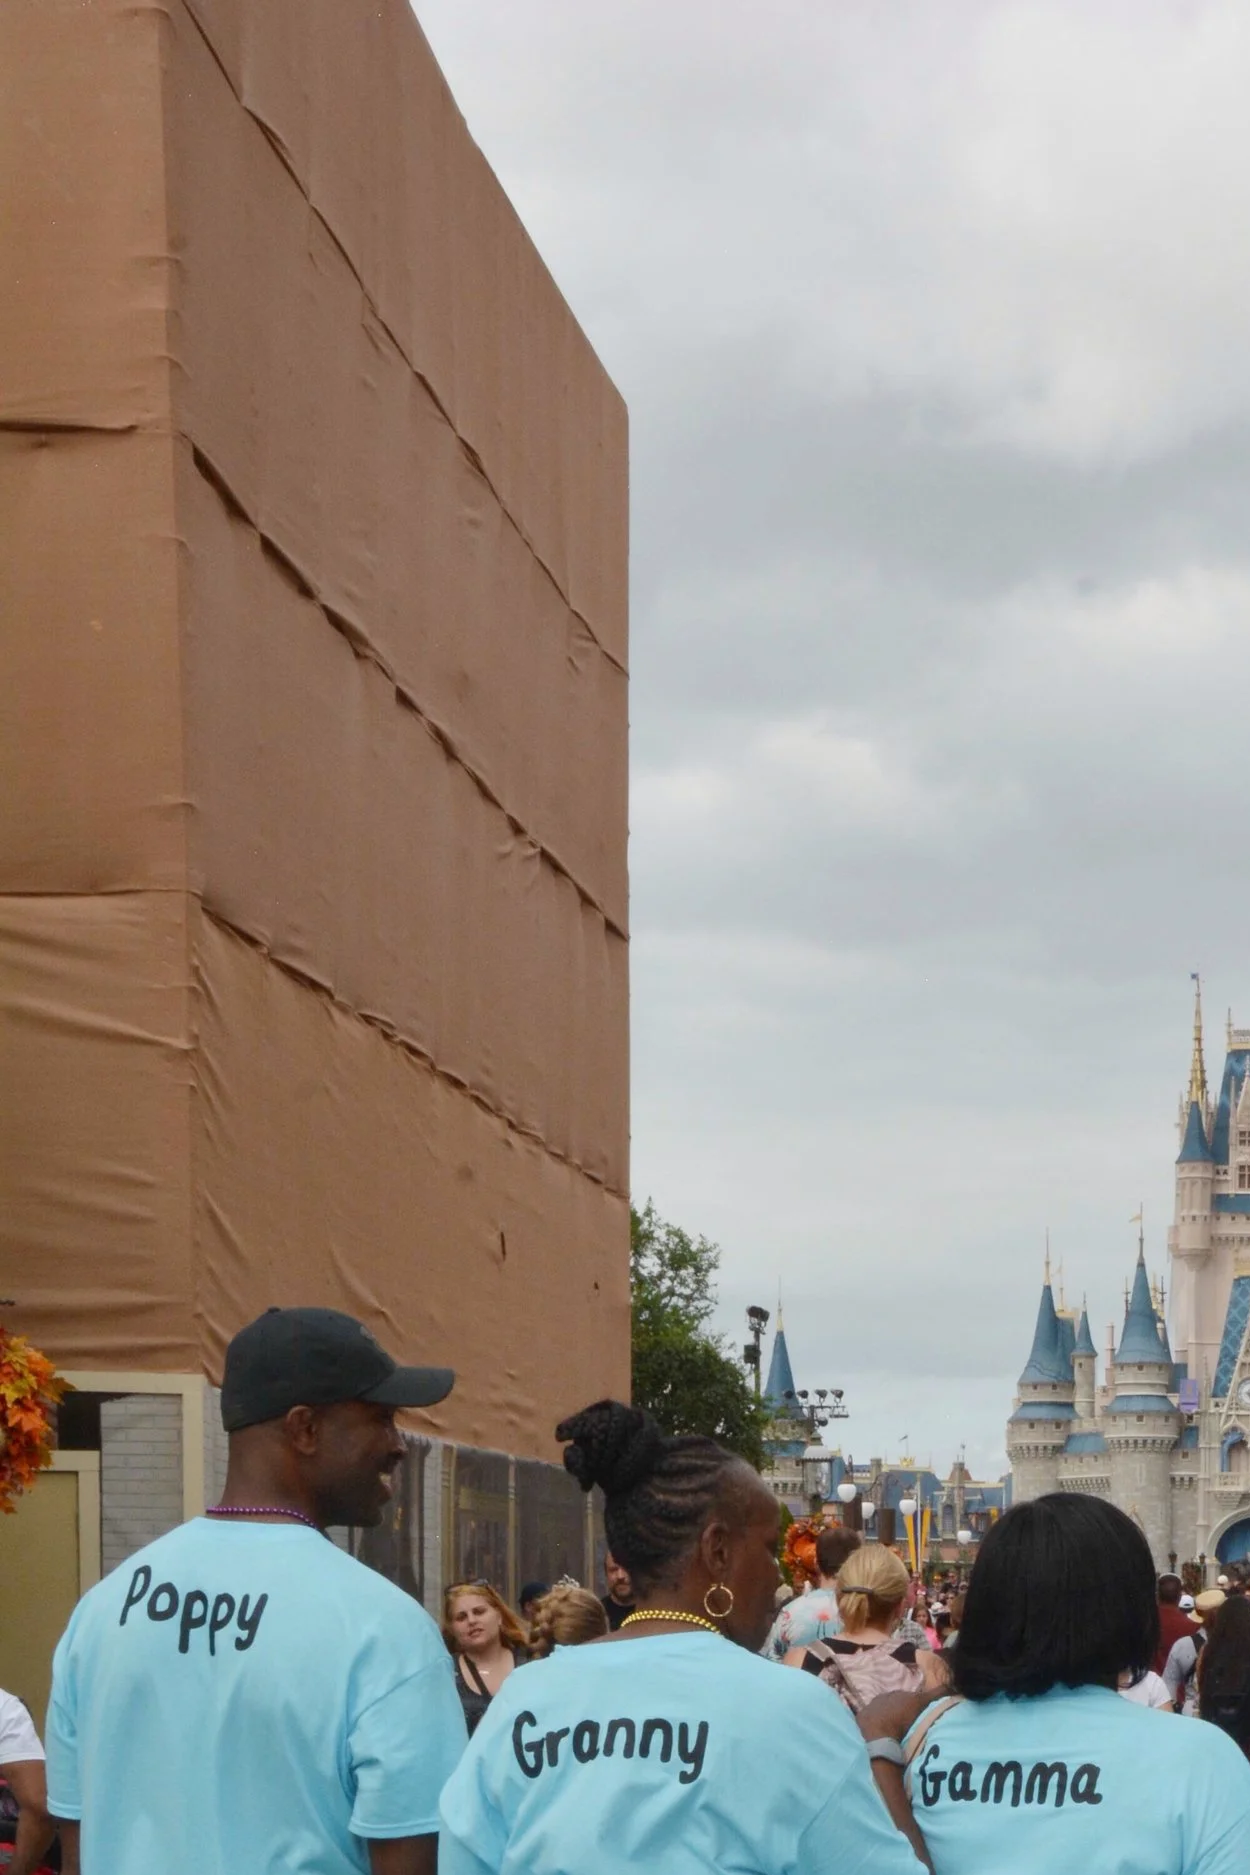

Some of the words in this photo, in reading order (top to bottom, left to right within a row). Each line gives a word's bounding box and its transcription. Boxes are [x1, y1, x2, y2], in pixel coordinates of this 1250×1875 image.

[120, 1565, 268, 1656] Poppy
[512, 1710, 709, 1784] Granny
[918, 1744, 1103, 1807] Gamma
